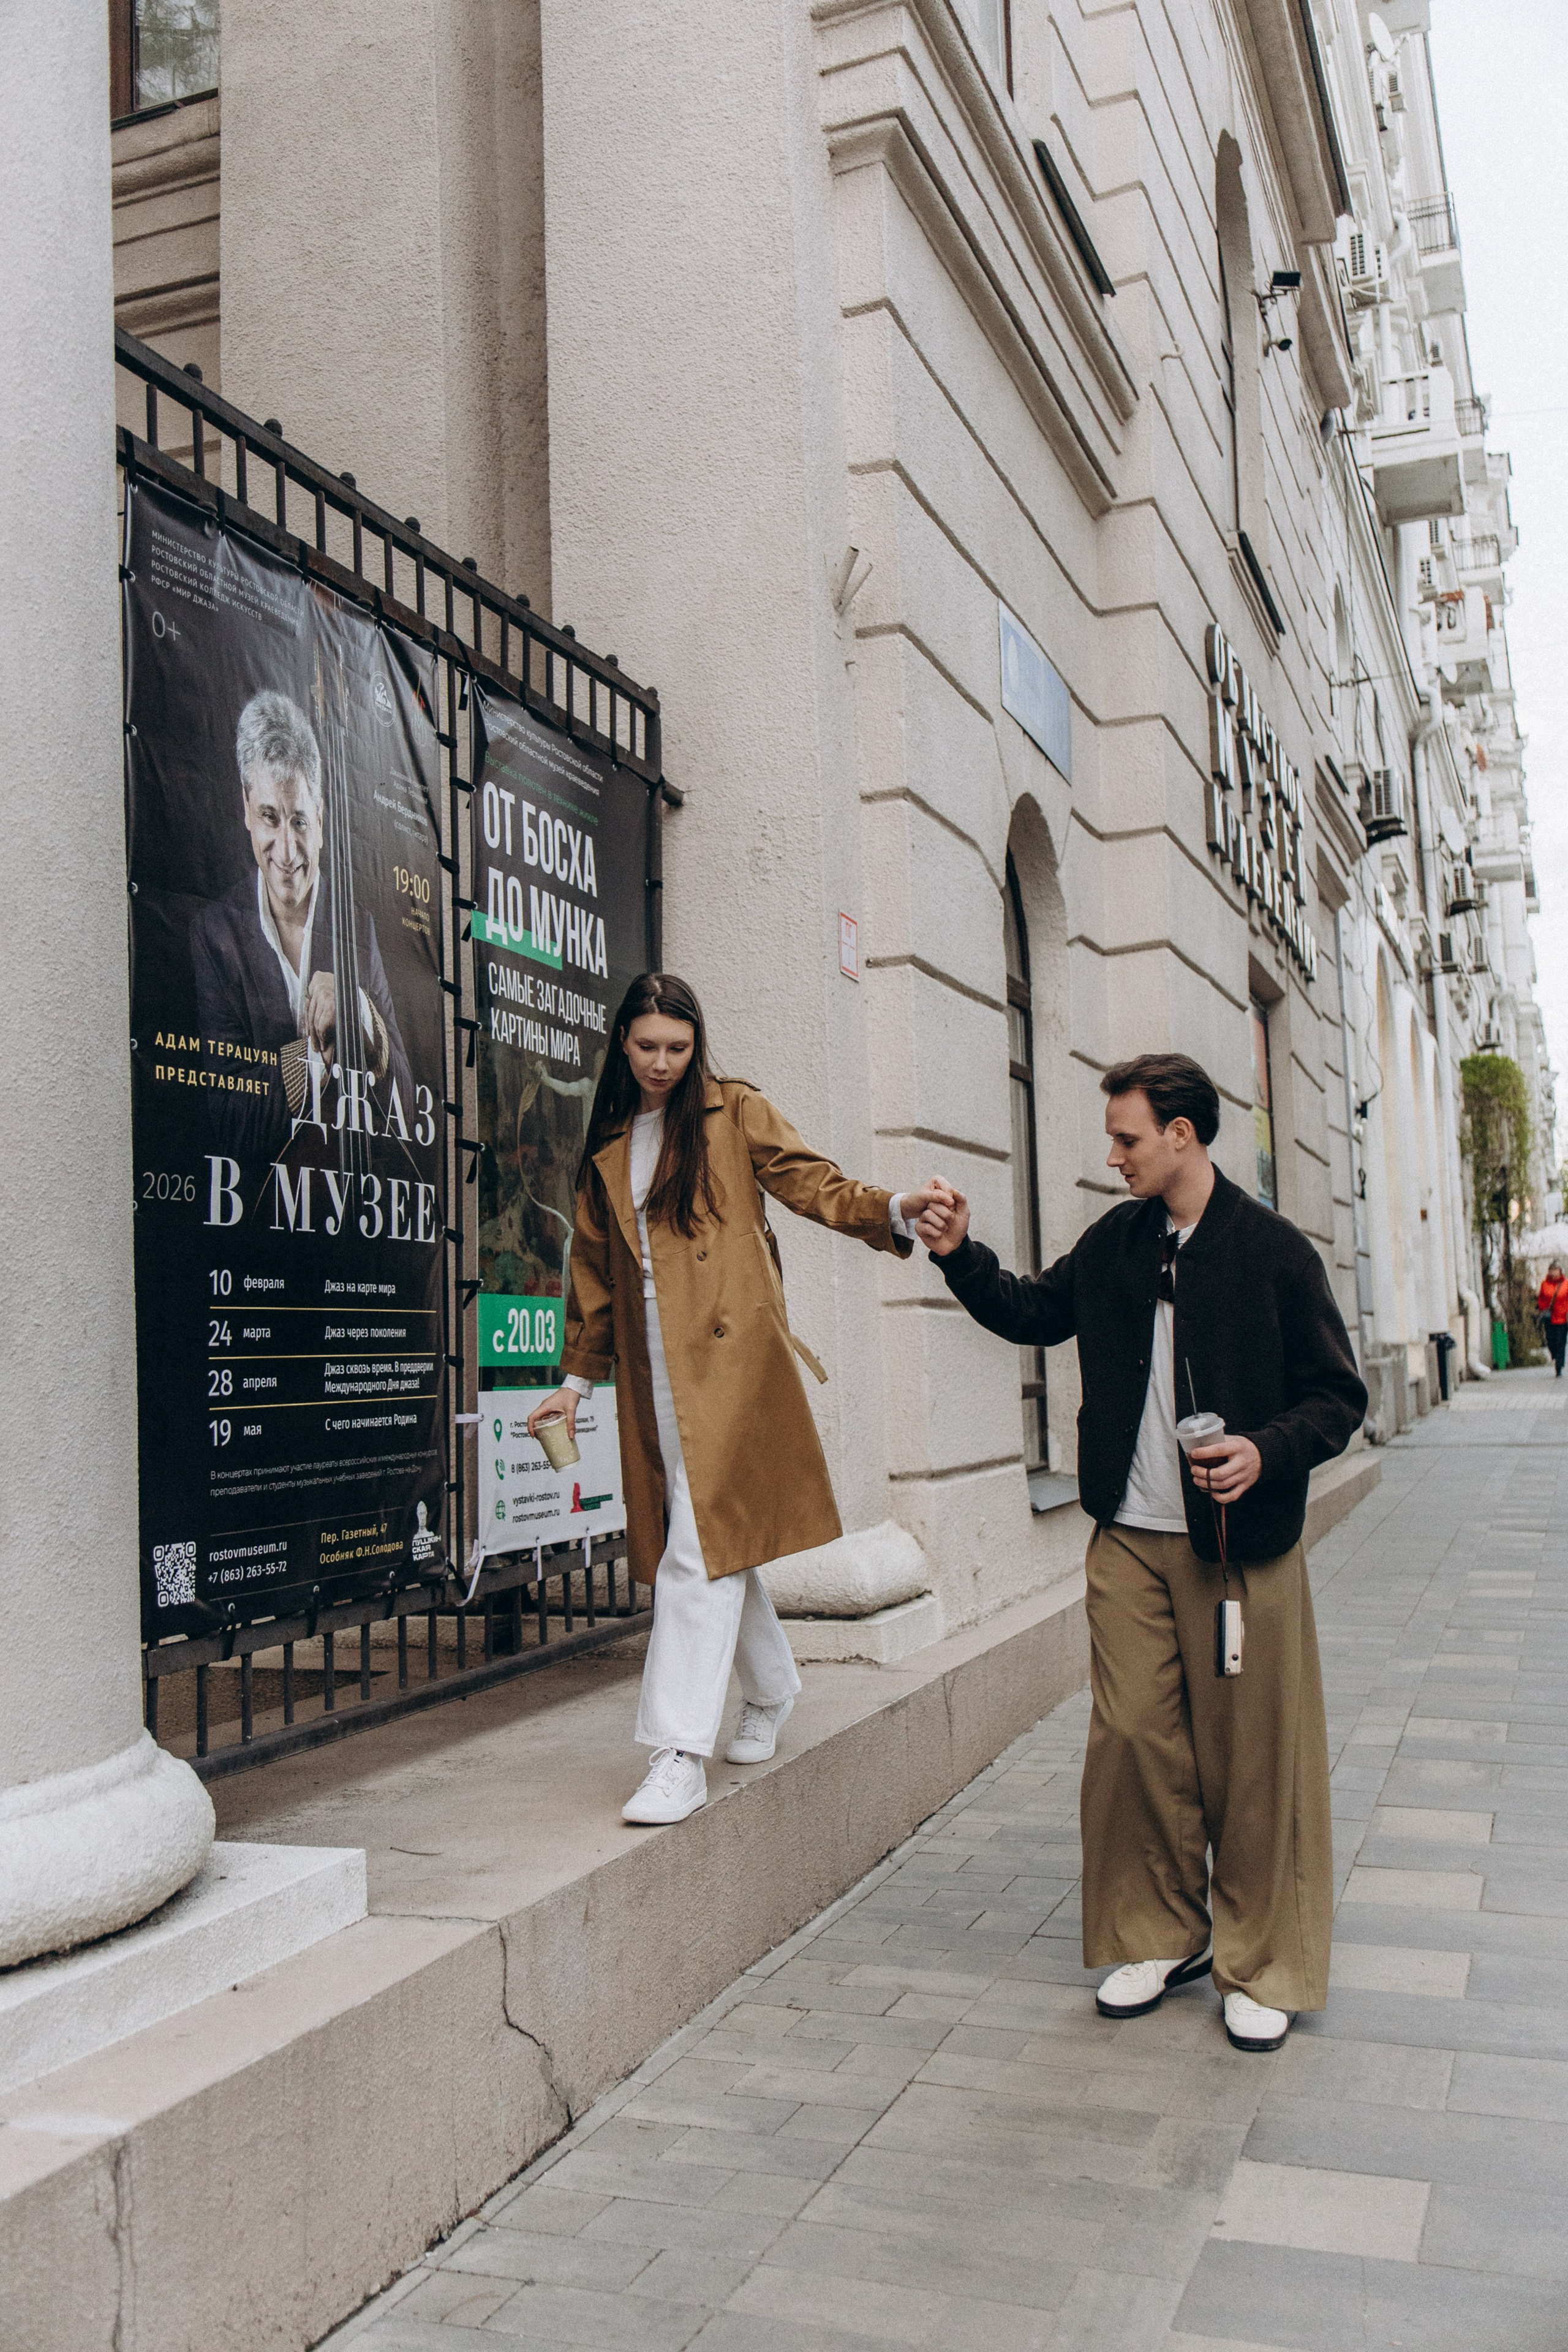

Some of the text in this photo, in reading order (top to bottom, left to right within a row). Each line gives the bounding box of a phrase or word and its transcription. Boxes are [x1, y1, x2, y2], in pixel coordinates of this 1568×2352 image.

[151, 545, 299, 626] РОСТОВСКИЙ ОБЛАСТНОЙ МУЗЕЙ КРАЕВЕДЕНИЯ
[152, 530, 304, 617] МИНИСТЕРСТВО КУЛЬТУРЫ РОСТОВСКОЙ ОБЛАСТИ
[151, 560, 262, 620] РОСТОВСКИЙ КОЛЛЕДЖ ИСКУССТВ
[151, 575, 219, 612] РФСР «МИР ДЖАЗА»
[153, 611, 181, 641] 0+
[483, 700, 603, 783] Министерство культуры Ростовской области
[484, 718, 518, 747] Ростовский
[519, 742, 548, 766] областной
[549, 760, 565, 775] музей
[484, 751, 518, 779] Выставка
[518, 774, 547, 794] полотен
[373, 790, 428, 826] Андрей Бердников
[483, 782, 597, 898] ОТ БОСХА
[393, 866, 430, 903] 19:00
[402, 917, 431, 936] КОНЦЕРТОВ
[411, 907, 430, 922] НАЧАЛО
[485, 866, 608, 979] ДО МУНКА
[488, 962, 607, 1035] САМЫЕ ЗАГАДОЧНЫЕ
[155, 1031, 277, 1066] АДАМ ТЕРАЦУЯН
[491, 1007, 581, 1067] КАРТИНЫ МИРА
[156, 1065, 270, 1096] ПРЕДСТАВЛЯЕТ
[292, 1057, 435, 1146] ДЖАЗ
[143, 1172, 195, 1202] 2026
[203, 1155, 435, 1243] В МУЗЕЕ
[209, 1269, 396, 1296] 10 февраля Джаз на карте мира
[208, 1320, 406, 1346] 24 марта Джаз через поколения
[492, 1308, 556, 1354] с 20.03
[208, 1361, 434, 1396] 28 апреля Джаз сквозь время. В преддверии
[325, 1377, 420, 1395] Международного Дня джаза!
[209, 1414, 417, 1447] 19 мая С чего начинается Родина
[210, 1471, 216, 1480] В
[217, 1469, 252, 1479] концертах
[254, 1465, 290, 1477] принимают
[290, 1463, 312, 1474] участие
[313, 1460, 339, 1471] лауреаты
[511, 1464, 515, 1473] 8
[516, 1462, 530, 1475] (863)
[210, 1484, 262, 1498] преподаватели
[268, 1480, 296, 1491] студенты
[296, 1477, 333, 1488] музыкальных
[333, 1472, 355, 1484] учебных
[512, 1491, 560, 1507] vystavki-rostov.ru
[512, 1509, 560, 1523] rostovmuseum.ru
[321, 1523, 388, 1545] Пер. Газетный, 47
[412, 1535, 442, 1547] ПУШКИН
[412, 1544, 431, 1554] СКАЯ
[209, 1541, 287, 1562] rostovmuseum.ru
[320, 1550, 353, 1564] Особняк
[412, 1551, 435, 1561] КАРТА
[208, 1561, 287, 1584] +7 (863) 263-55-72
